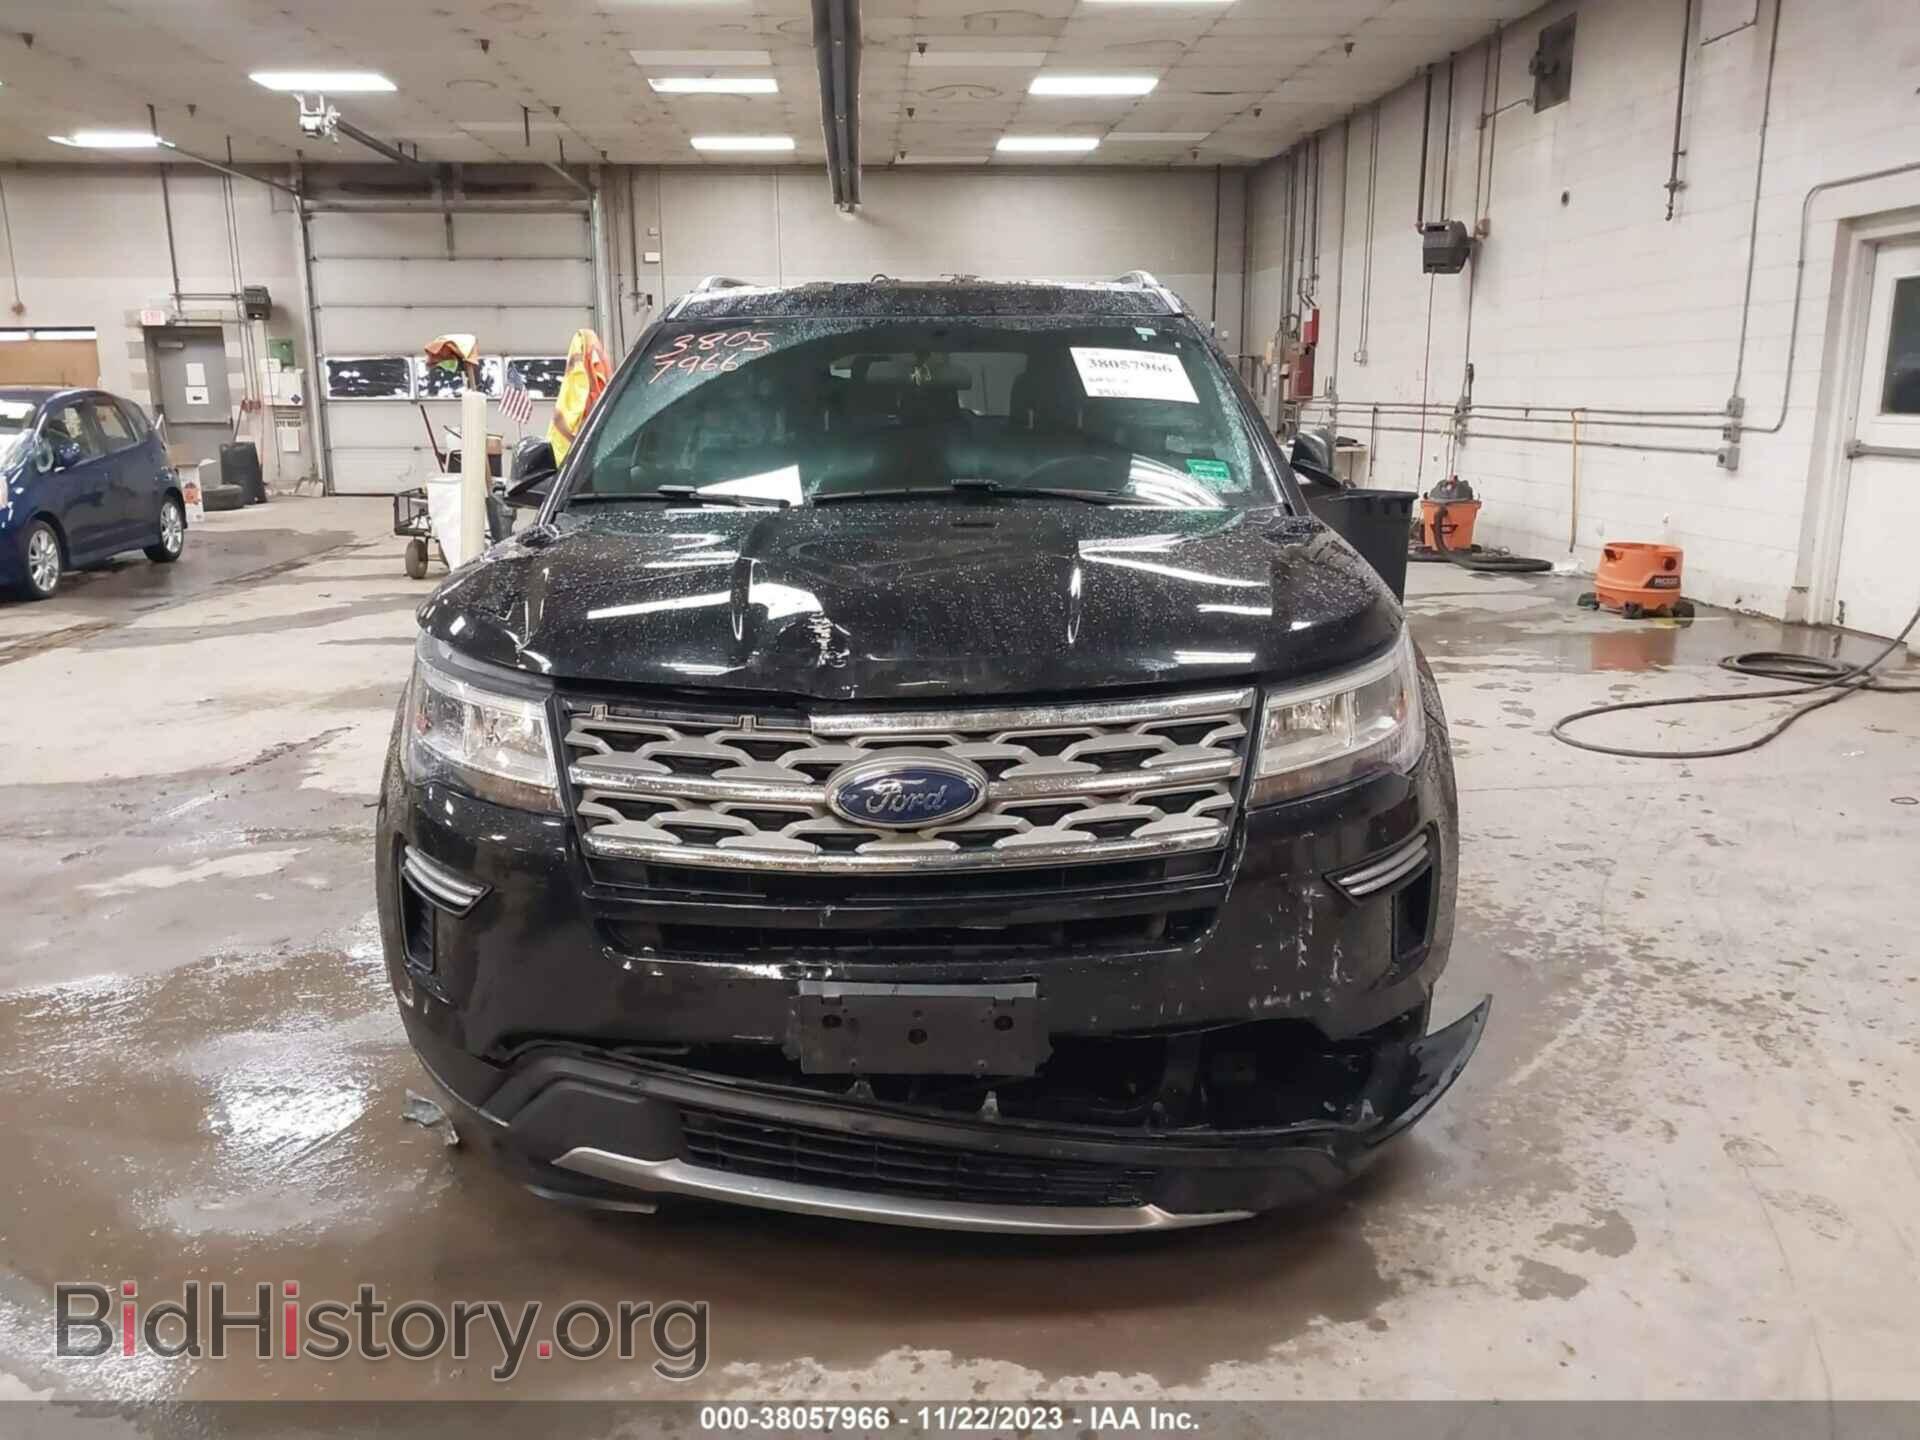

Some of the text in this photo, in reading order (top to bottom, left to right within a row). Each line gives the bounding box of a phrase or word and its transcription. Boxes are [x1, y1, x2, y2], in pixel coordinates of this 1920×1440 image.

[653, 331, 776, 360] 3805
[647, 352, 740, 385] 7966
[1088, 358, 1174, 374] 38057966
[861, 778, 948, 814] Ford
